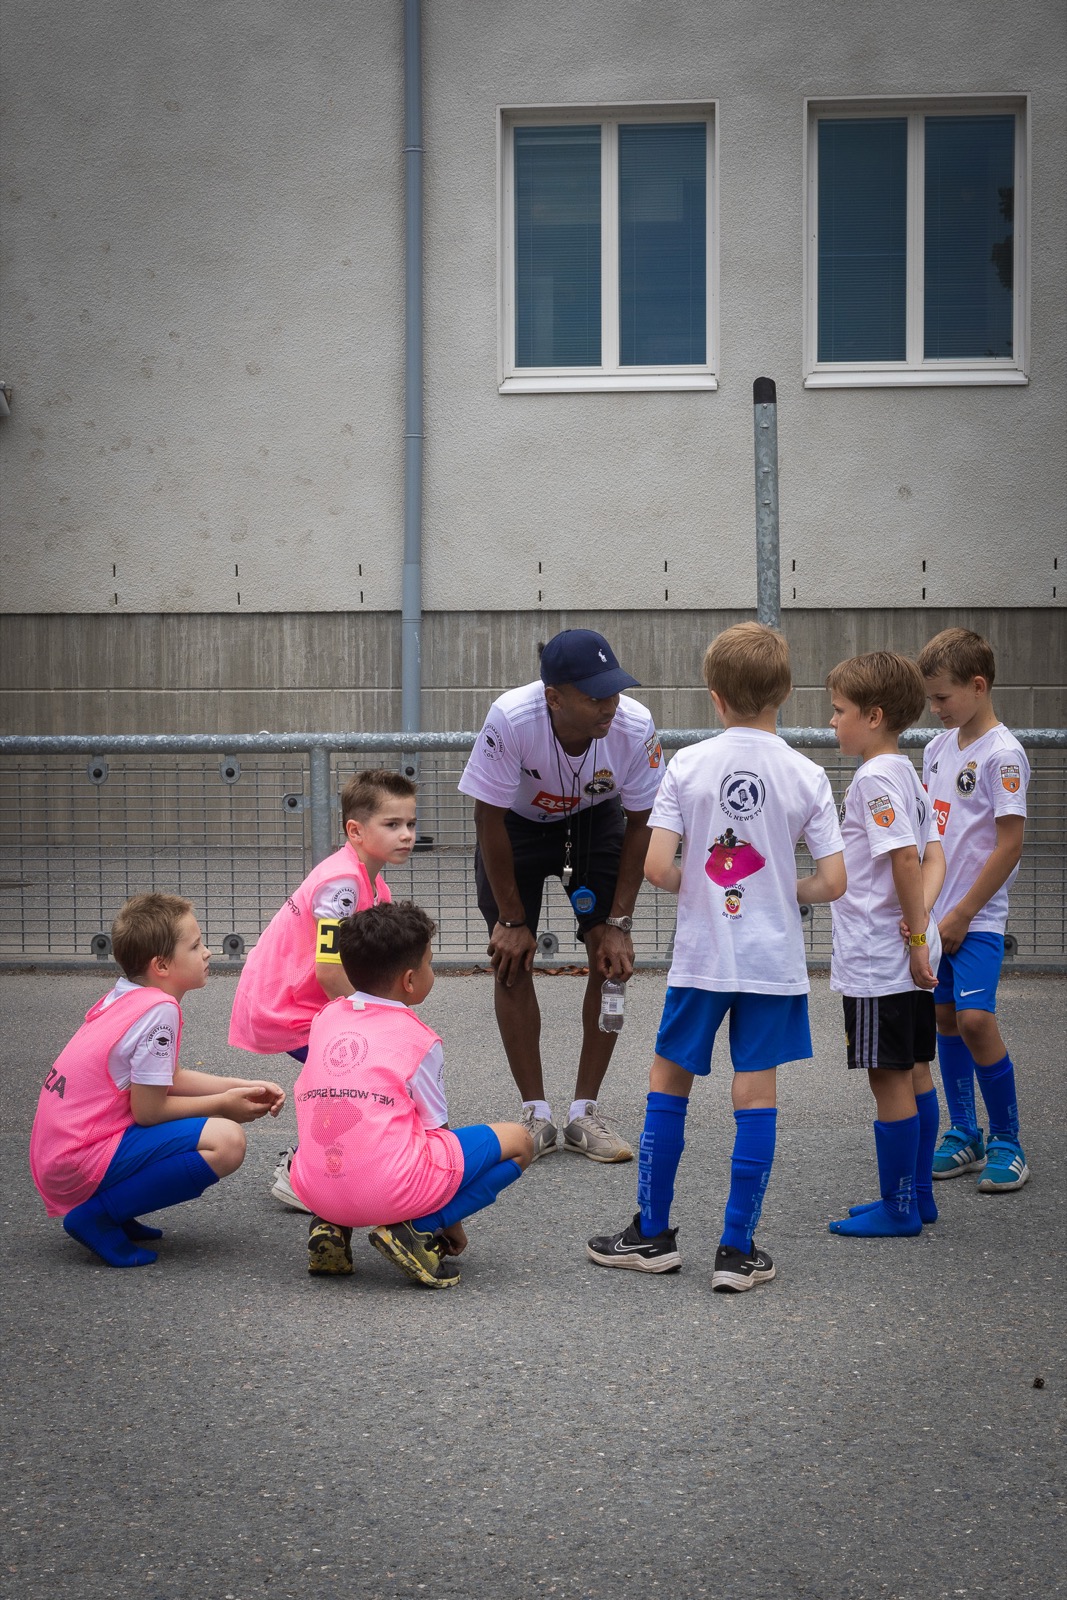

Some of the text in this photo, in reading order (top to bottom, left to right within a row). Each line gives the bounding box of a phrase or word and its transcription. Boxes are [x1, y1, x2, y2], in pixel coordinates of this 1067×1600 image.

[538, 797, 572, 809] as
[720, 801, 763, 822] REAL NEWS TV
